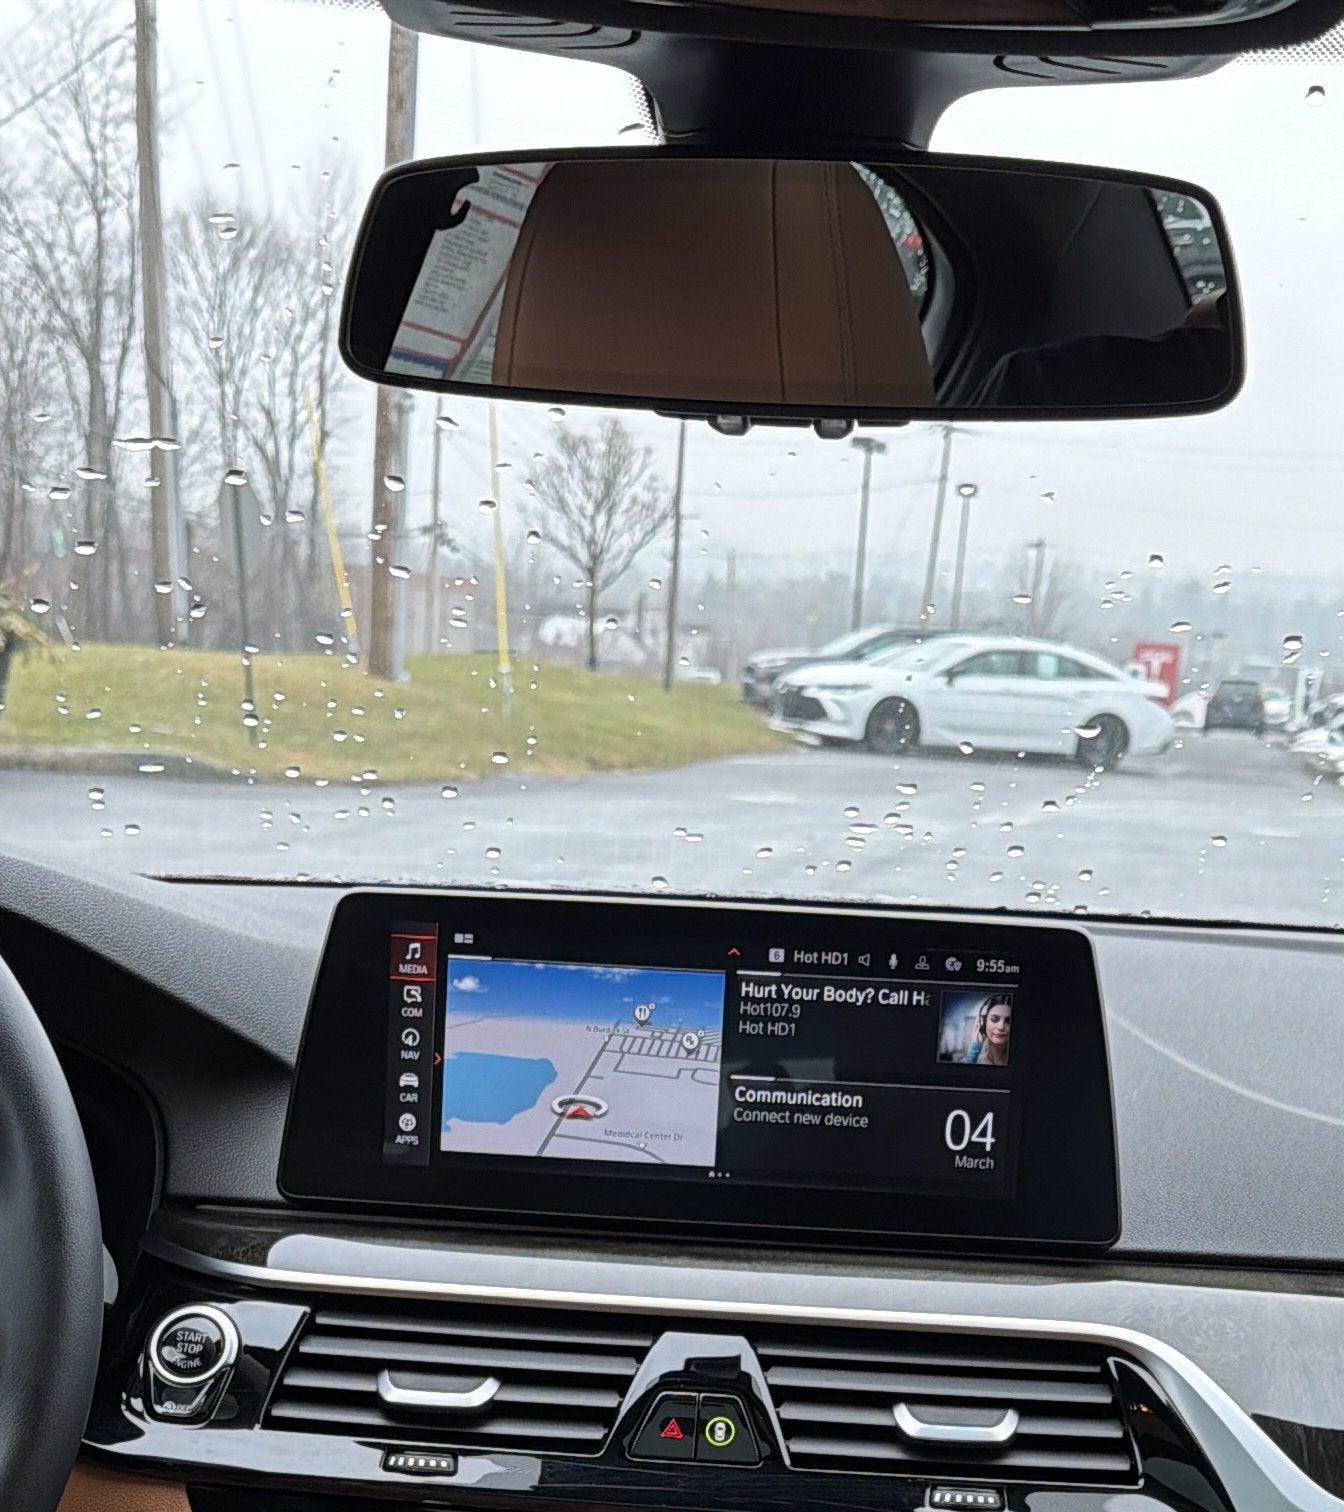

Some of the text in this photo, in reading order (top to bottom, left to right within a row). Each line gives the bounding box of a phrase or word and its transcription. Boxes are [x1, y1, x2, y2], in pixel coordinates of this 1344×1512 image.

[794, 951, 818, 964] Hot
[821, 952, 849, 965] HD1
[399, 964, 428, 975] MEDIA
[977, 959, 1020, 973] 9:55am
[741, 982, 778, 999] Hurt
[780, 984, 820, 1001] Your
[824, 986, 874, 1006] Body?
[878, 989, 907, 1005] Call
[402, 1007, 422, 1017] COM
[739, 1002, 801, 1019] Hot107.9
[739, 1021, 796, 1037] Hot HD1
[401, 1050, 420, 1060] NAV
[399, 1093, 418, 1103] CAR
[734, 1086, 863, 1108] Communication
[733, 1107, 868, 1128] Connect new device
[644, 1131, 671, 1140] Center
[674, 1133, 684, 1141] Dr
[945, 1109, 995, 1152] 04
[395, 1135, 419, 1146] APPS
[954, 1155, 994, 1170] March
[176, 1330, 207, 1343] START
[176, 1342, 204, 1354] STOP
